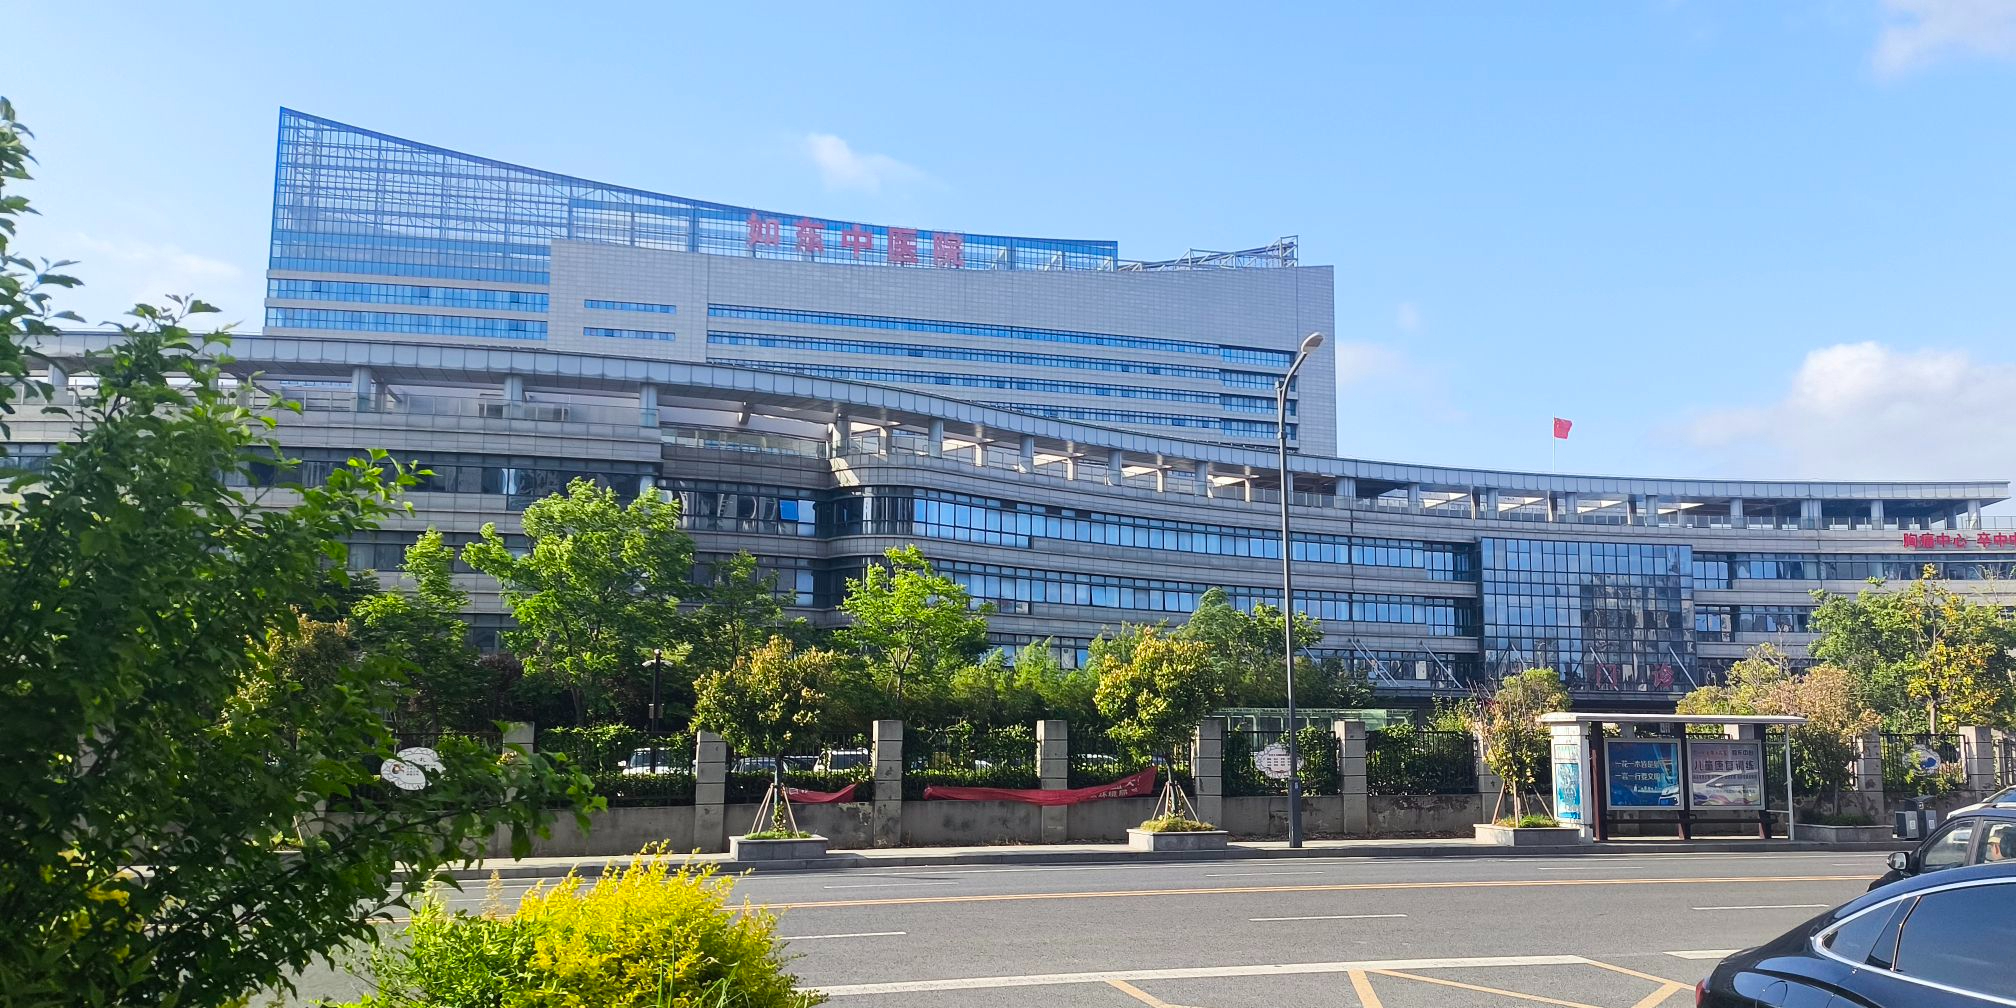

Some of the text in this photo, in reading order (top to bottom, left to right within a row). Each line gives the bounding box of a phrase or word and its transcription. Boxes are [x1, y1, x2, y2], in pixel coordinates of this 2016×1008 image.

[746, 211, 964, 268] 如东中医院
[1903, 532, 1967, 548] 胸痛中心
[1596, 662, 1674, 688] 门诊
[1694, 760, 1755, 770] 儿童康复训练
